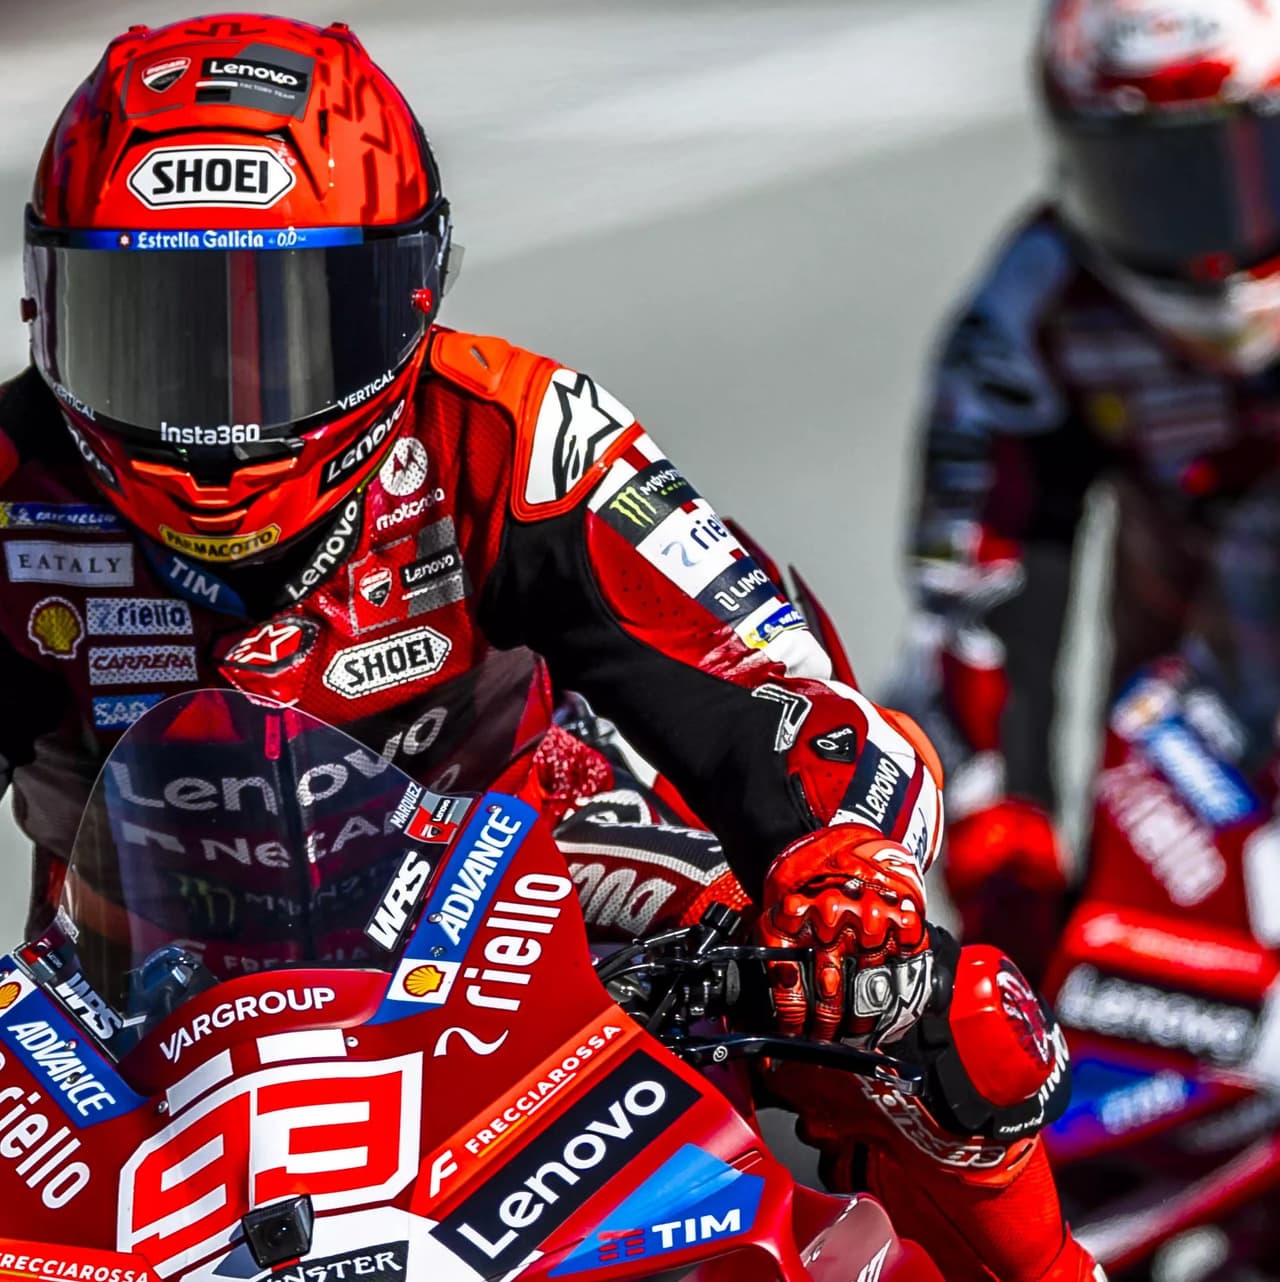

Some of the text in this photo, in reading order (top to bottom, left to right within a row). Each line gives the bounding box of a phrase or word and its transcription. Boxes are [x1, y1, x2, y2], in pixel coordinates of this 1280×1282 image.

[210, 60, 298, 87] Lenovo
[152, 158, 269, 195] SHOEI
[136, 231, 200, 249] Estrella
[202, 230, 264, 249] Galicia
[337, 370, 396, 410] VERTICAL
[160, 421, 260, 445] Insta360
[326, 398, 405, 483] Lenovo
[376, 487, 445, 532] motorola
[17, 552, 122, 574] EATALY
[166, 530, 273, 558] PARMACOTTO
[287, 499, 359, 600] Lenovo
[169, 556, 220, 604] TIM
[404, 554, 455, 584] Lenovo
[116, 601, 186, 628] riello
[93, 652, 193, 671] CARRERA
[343, 636, 436, 689] SHOEI
[108, 707, 448, 816] Lenovo
[389, 781, 422, 829] MARQUEZ
[432, 799, 452, 822] Lenovo
[855, 757, 901, 825] Lenovo
[367, 850, 431, 950] WRS
[436, 806, 522, 946] ADVANCE
[464, 873, 573, 1013] riello
[55, 972, 124, 1040] WRS
[160, 986, 335, 1063] VARGROUP
[7, 1019, 117, 1117] ADVANCE
[465, 1024, 622, 1154] FRECCIAROSSA
[456, 1079, 667, 1260] Lenovo
[651, 1208, 741, 1250] TIM
[267, 1251, 403, 1282] NSTER
